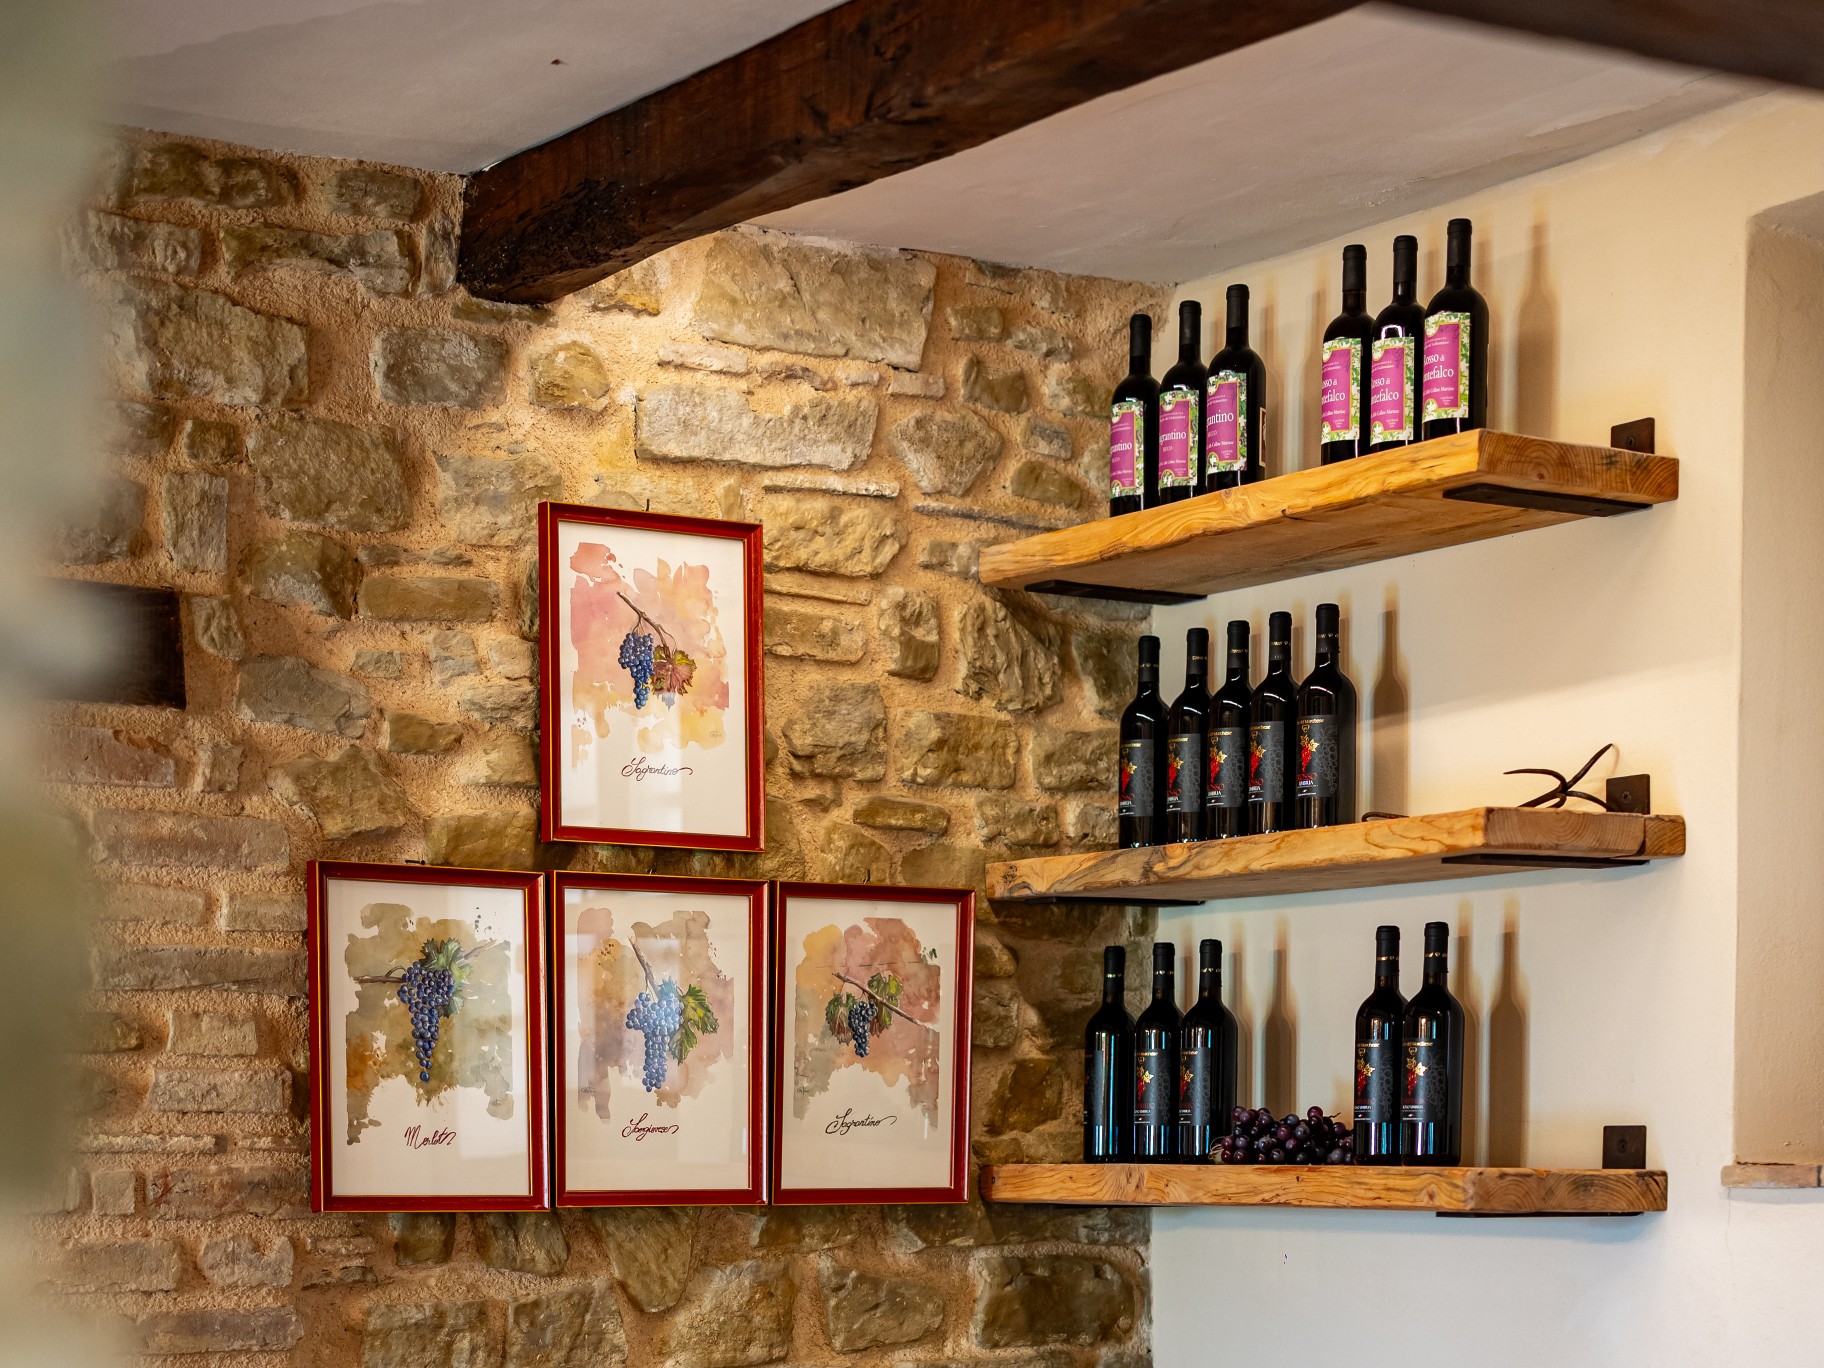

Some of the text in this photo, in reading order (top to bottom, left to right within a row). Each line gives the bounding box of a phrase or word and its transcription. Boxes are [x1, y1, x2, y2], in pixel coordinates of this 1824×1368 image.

[621, 756, 693, 782] Sagrantino
[622, 1112, 680, 1141] Sangiovese
[825, 1108, 898, 1135] Sagrantino
[404, 1125, 456, 1149] Merlot
